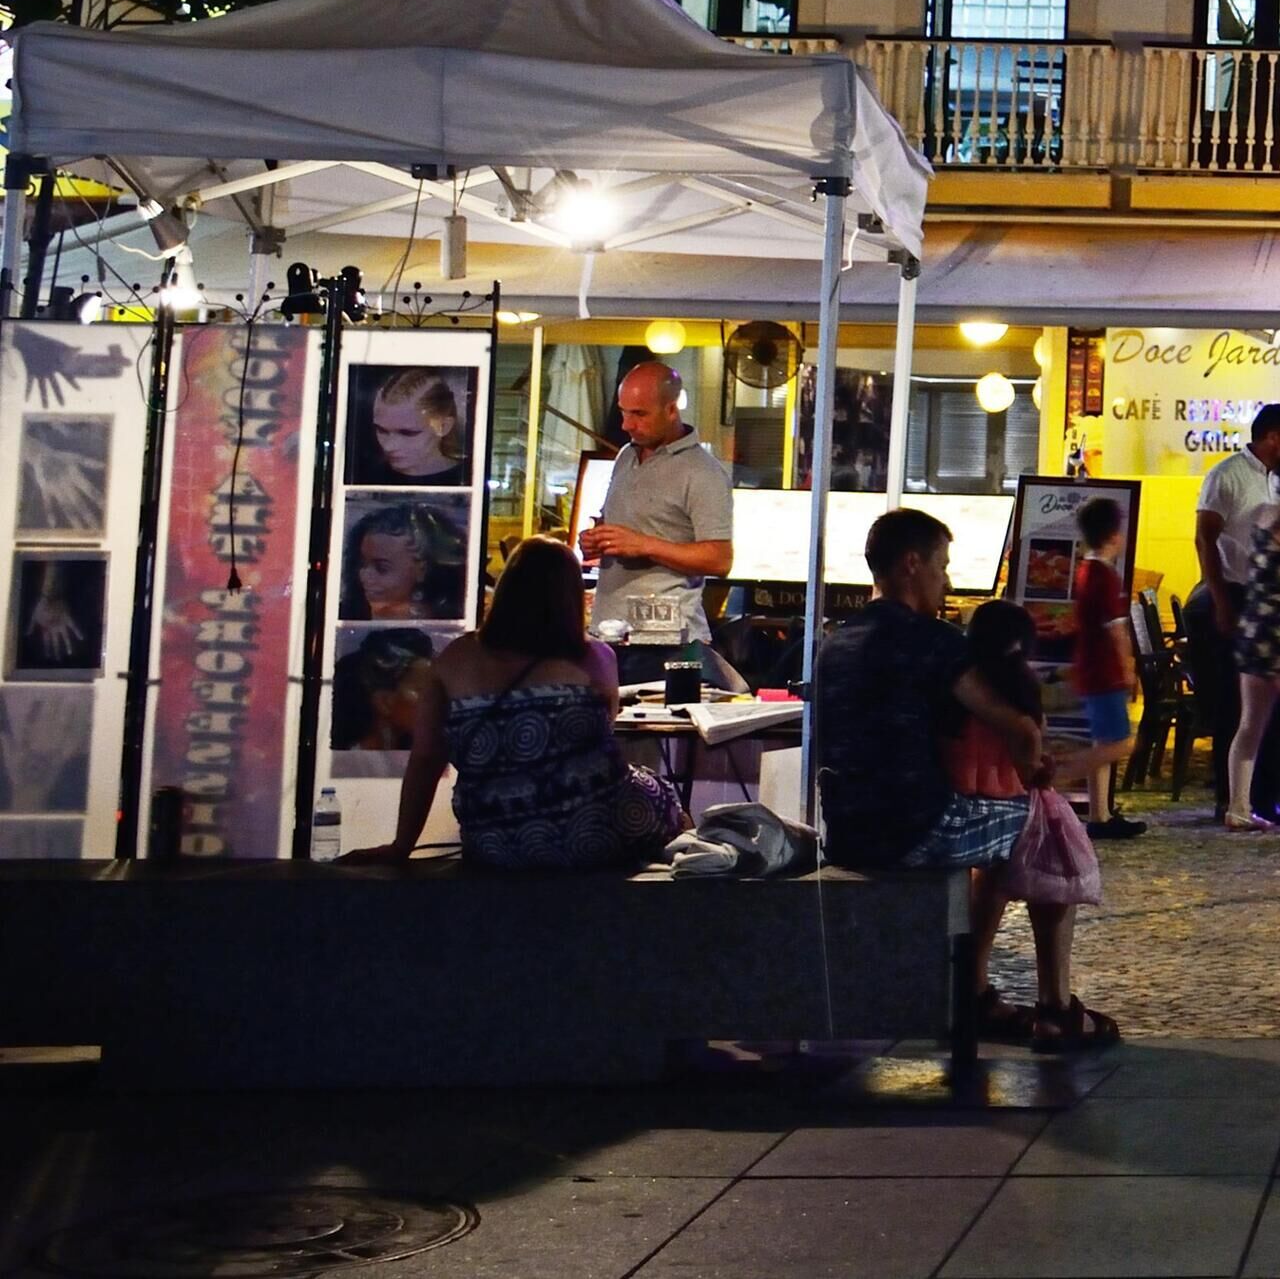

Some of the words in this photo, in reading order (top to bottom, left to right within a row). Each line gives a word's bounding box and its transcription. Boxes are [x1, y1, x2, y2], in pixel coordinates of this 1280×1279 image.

[1112, 329, 1193, 364] Doce
[1112, 393, 1162, 421] CAFÉ
[1184, 430, 1242, 453] GRILL
